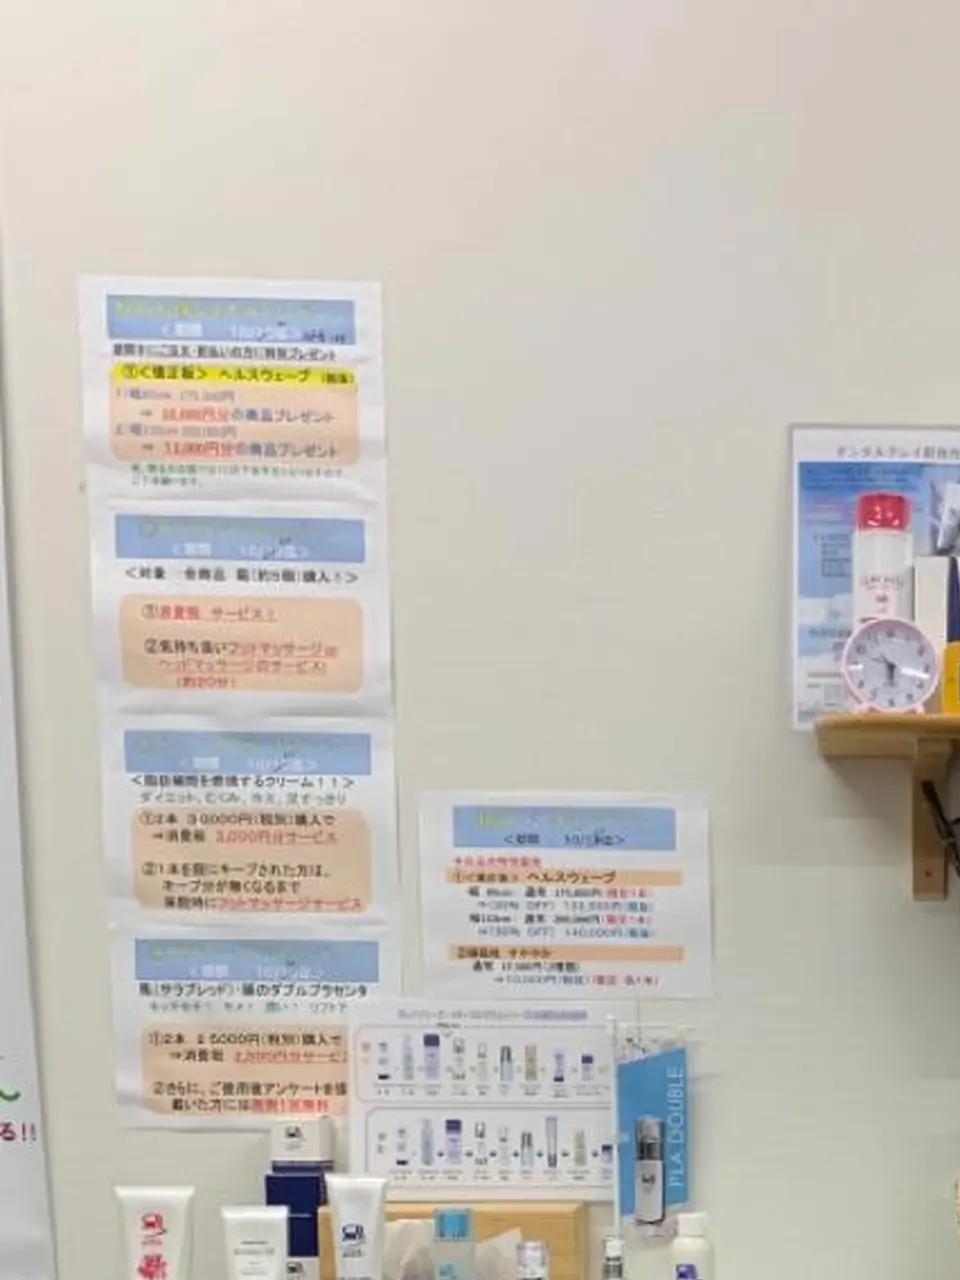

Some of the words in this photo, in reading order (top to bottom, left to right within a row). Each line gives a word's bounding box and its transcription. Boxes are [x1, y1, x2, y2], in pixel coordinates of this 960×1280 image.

[218, 366, 311, 383] ヘルスウェーブ
[666, 1066, 685, 1144] DOUBLE
